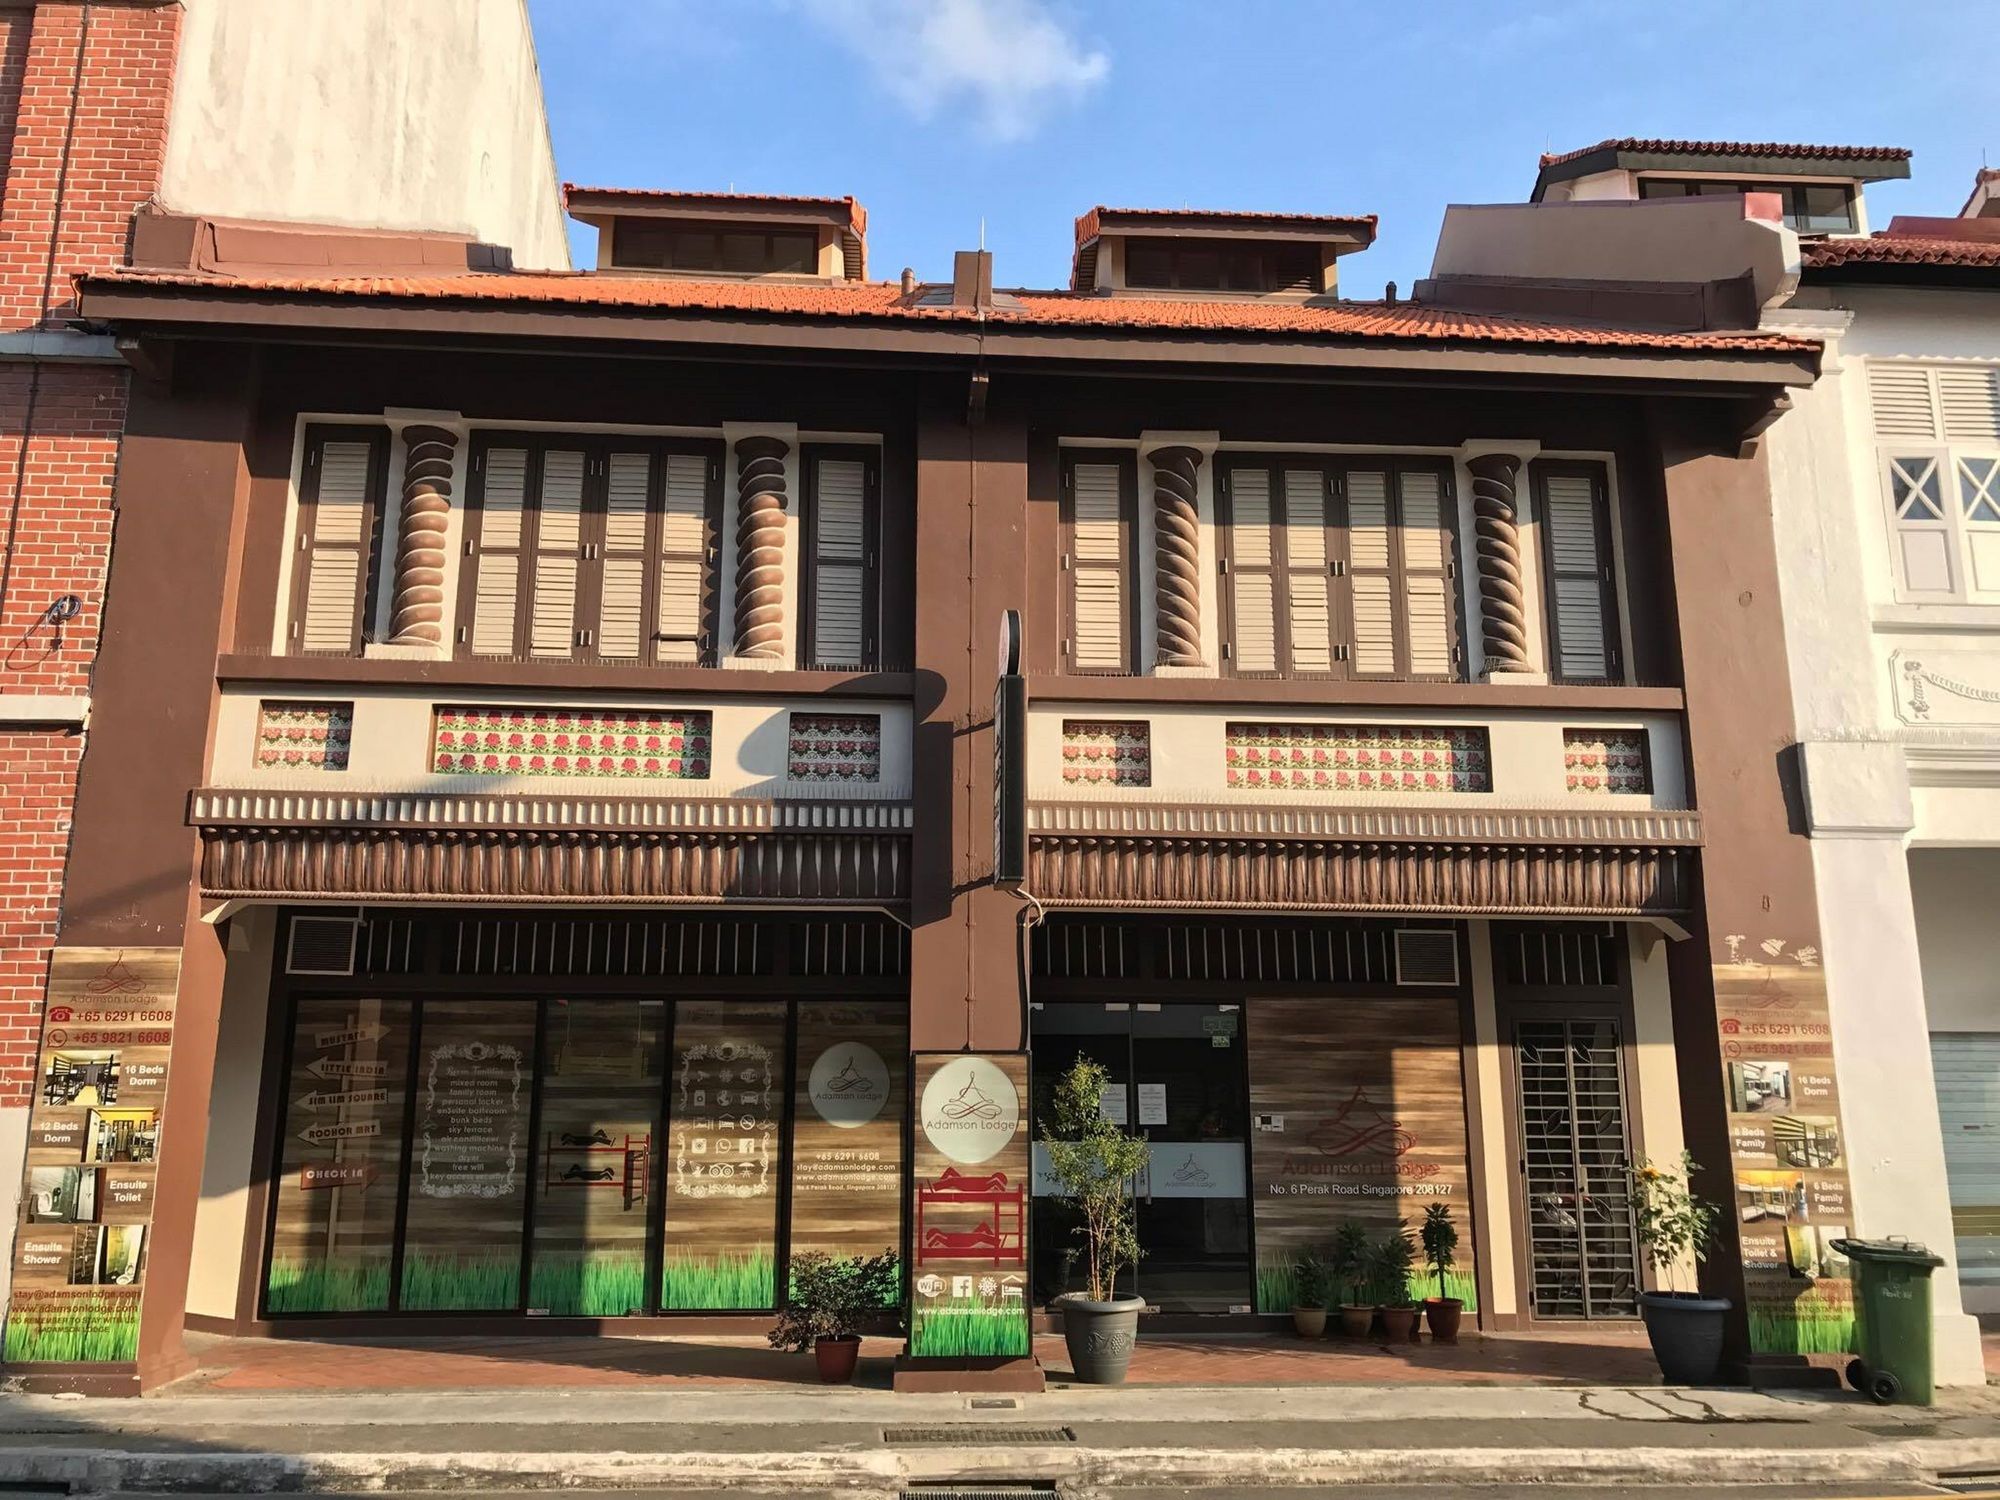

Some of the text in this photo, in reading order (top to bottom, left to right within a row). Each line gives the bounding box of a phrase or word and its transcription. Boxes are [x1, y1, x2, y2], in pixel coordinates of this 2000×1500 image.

[76, 1010, 173, 1022] +65 6291 6608
[1744, 1024, 1829, 1035] +65 6291 6608
[73, 1032, 171, 1044] +65 9821 6608
[124, 1065, 164, 1075] 16 Beds
[129, 1077, 157, 1086] Dorm
[1809, 1076, 1832, 1086] Beds
[1804, 1087, 1828, 1096] Dorm
[308, 1094, 326, 1105] SIM
[40, 1122, 79, 1132] 12 Beds
[926, 1120, 1016, 1132] Adamson Lodge
[1741, 1128, 1766, 1137] Beds
[44, 1134, 71, 1144] Dorm
[1736, 1139, 1766, 1149] Family
[816, 1152, 880, 1161] +65 6291 6608
[1737, 1150, 1766, 1159] Room
[796, 1163, 896, 1172] stay@adamsonlodge.com
[1281, 1157, 1441, 1181] Adamson Lodge
[306, 1168, 348, 1180] CHECK
[109, 1180, 148, 1190] Ensuite
[1821, 1182, 1844, 1191] Beds
[1269, 1184, 1453, 1198] No. 6 Perak Road Singapore 208127
[114, 1192, 142, 1202] Toilet
[1814, 1193, 1843, 1203] Family
[1818, 1205, 1845, 1214] Room
[1742, 1236, 1777, 1246] Ensuite
[24, 1242, 63, 1252] Ensuite
[1743, 1248, 1778, 1258] Toilet &
[23, 1254, 62, 1264] Shower
[1743, 1260, 1779, 1269] Shower
[916, 1307, 1026, 1317] www.adamsonlodge.com
